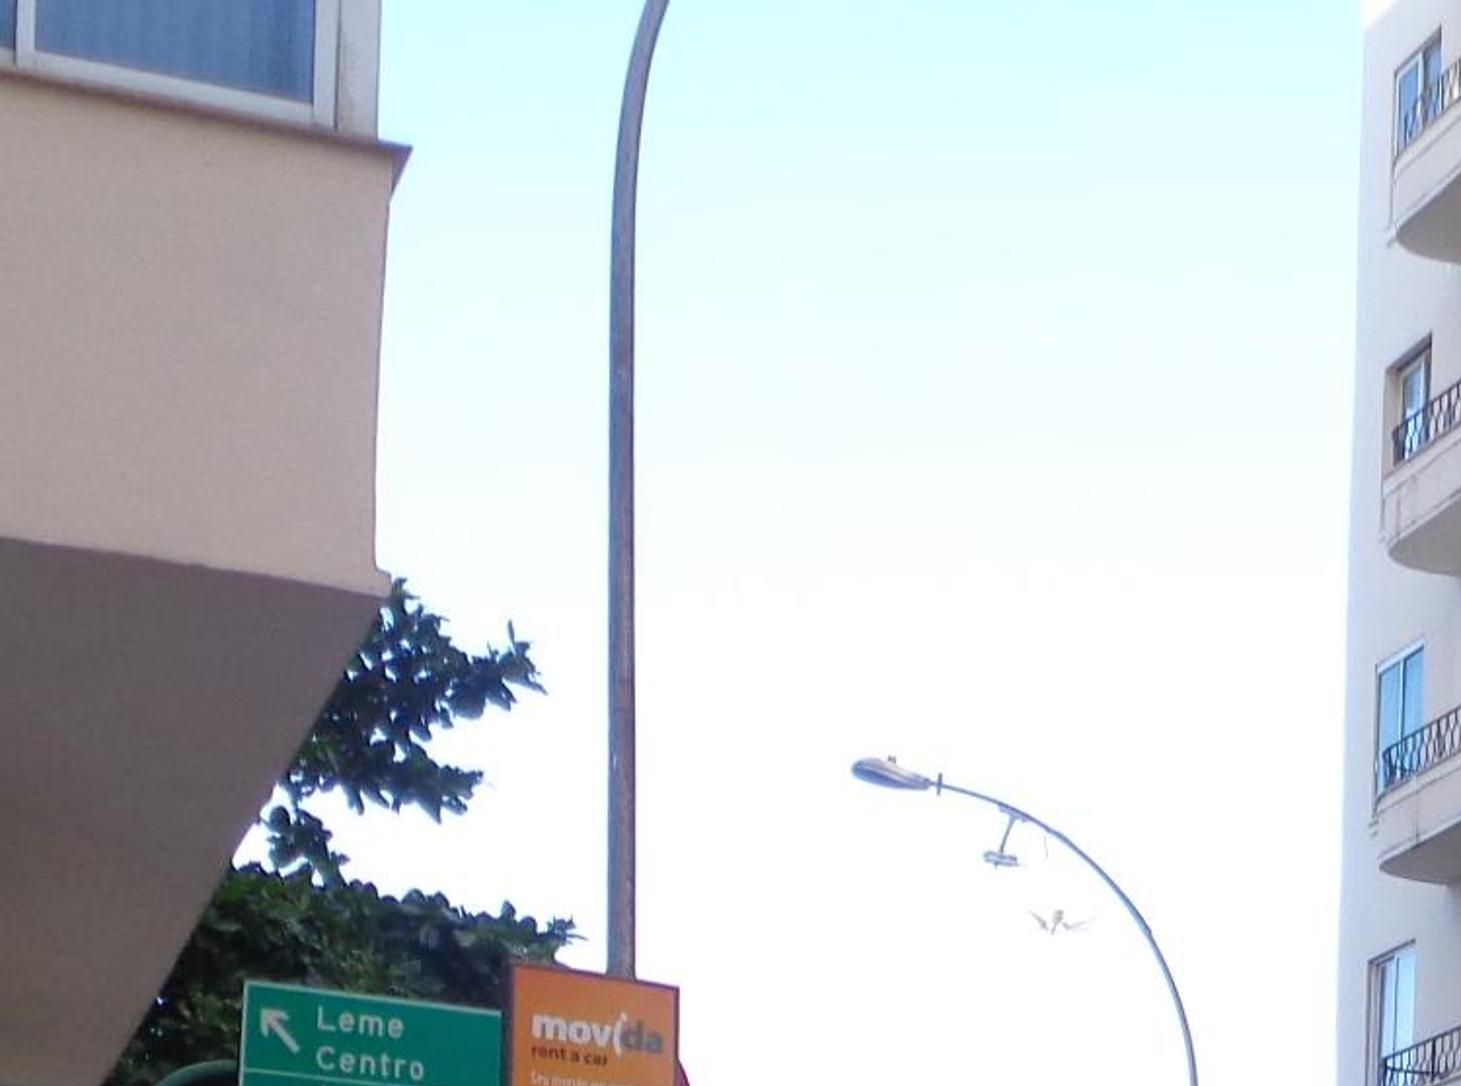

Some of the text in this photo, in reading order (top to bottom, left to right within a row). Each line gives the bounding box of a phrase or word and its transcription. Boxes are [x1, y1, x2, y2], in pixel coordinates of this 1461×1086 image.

[316, 1005, 405, 1039] Leme
[531, 1012, 664, 1058] movida
[315, 1045, 425, 1082] Centro
[531, 1046, 609, 1066] rent a car
